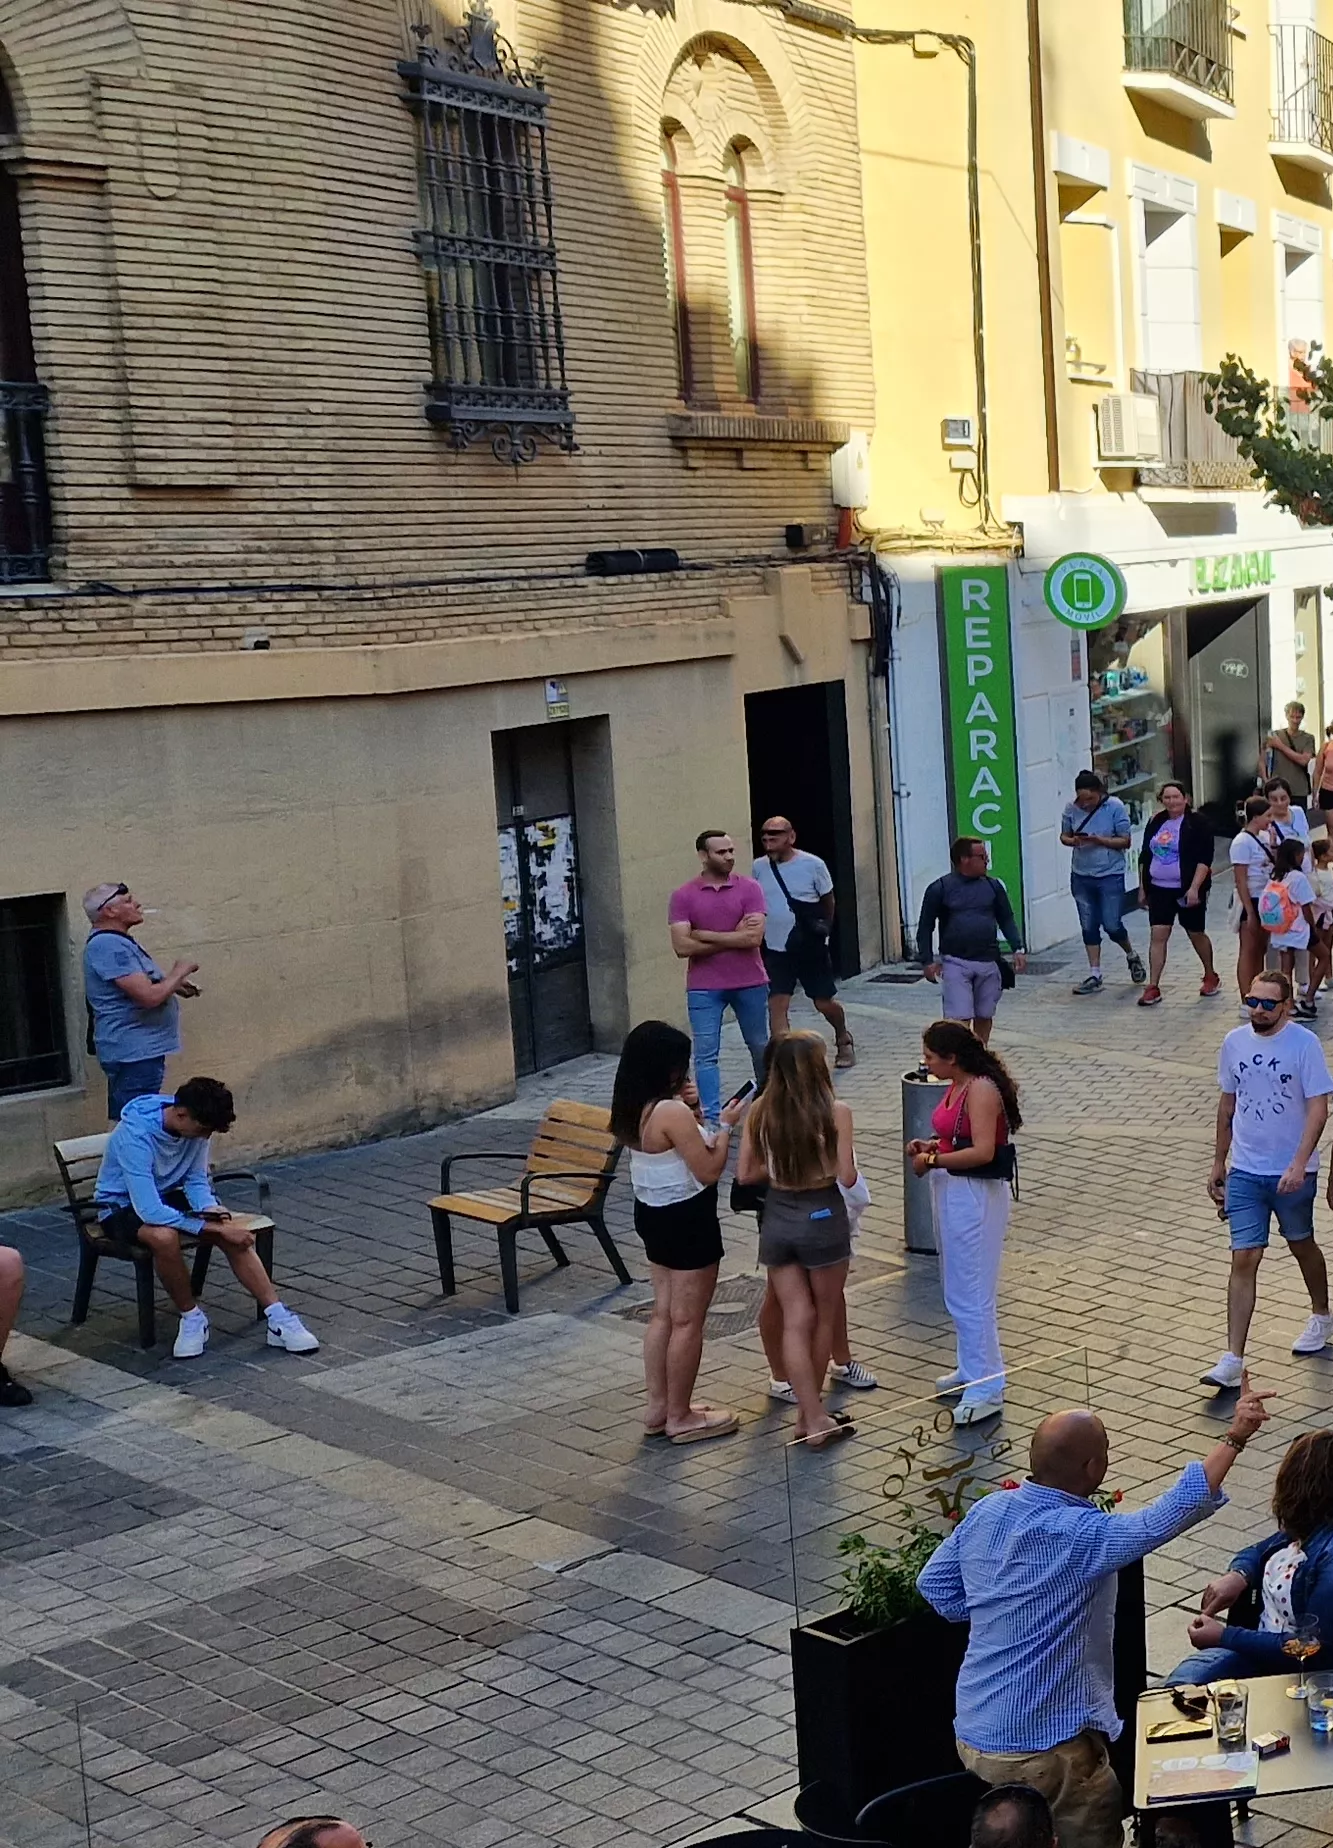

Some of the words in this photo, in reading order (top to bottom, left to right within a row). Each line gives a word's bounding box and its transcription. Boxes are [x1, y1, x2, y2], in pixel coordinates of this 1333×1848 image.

[1061, 561, 1103, 575] PLAZA
[959, 578, 1008, 940] REPARACI
[1234, 1053, 1281, 1084] JACK
